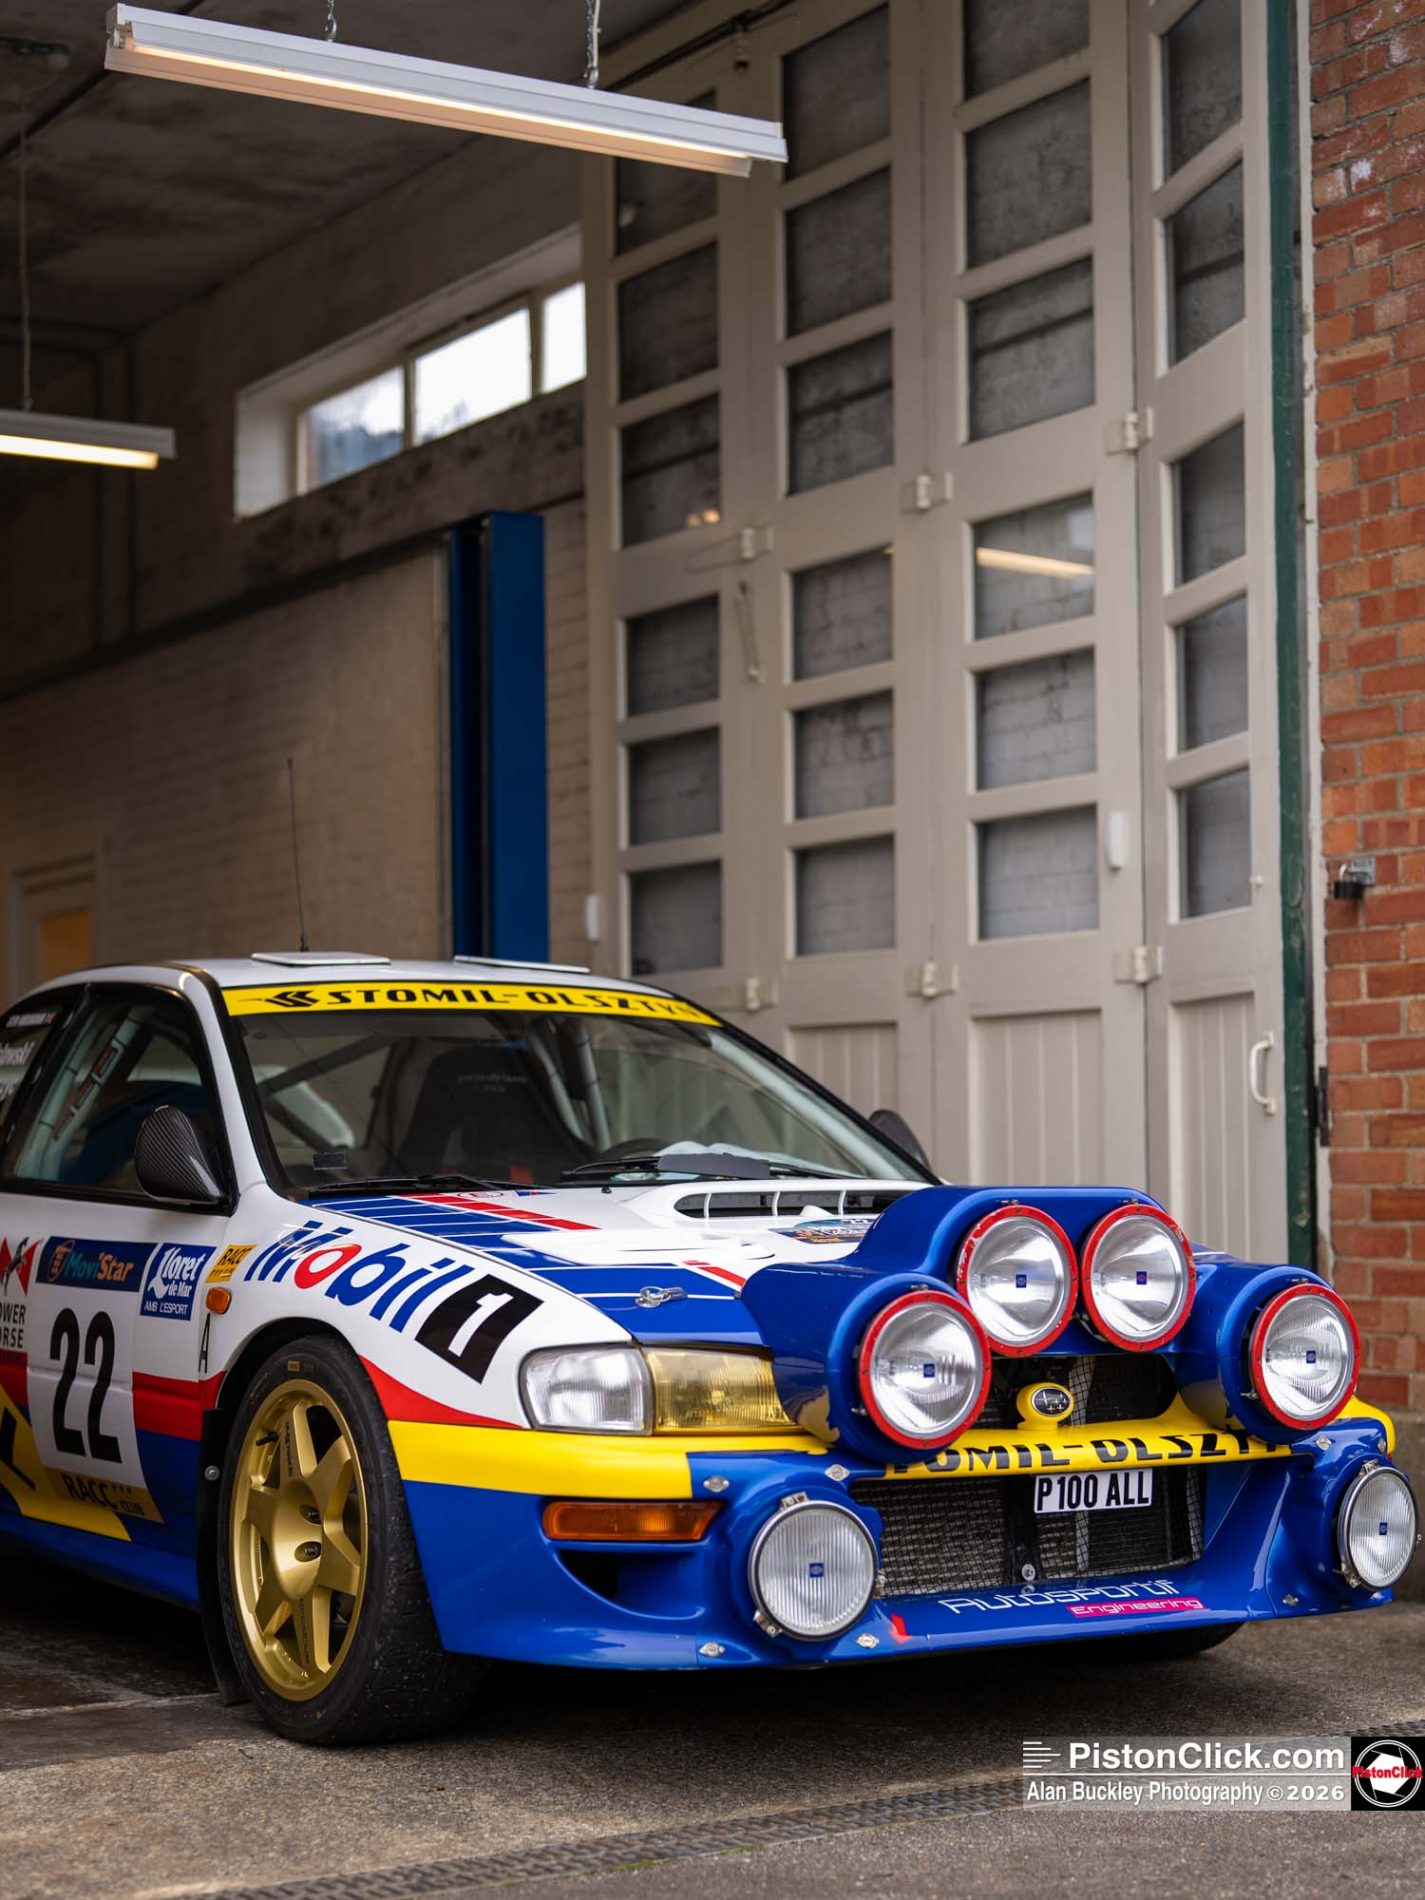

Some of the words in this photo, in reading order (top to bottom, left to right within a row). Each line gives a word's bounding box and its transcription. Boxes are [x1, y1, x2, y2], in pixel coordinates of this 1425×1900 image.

[168, 1280, 178, 1296] de
[177, 1281, 192, 1297] Mar
[243, 1220, 475, 1333] Mobil
[50, 1308, 122, 1464] 22
[1036, 1473, 1098, 1512] P100
[1105, 1471, 1150, 1507] ALL
[1070, 1598, 1203, 1615] Engineering
